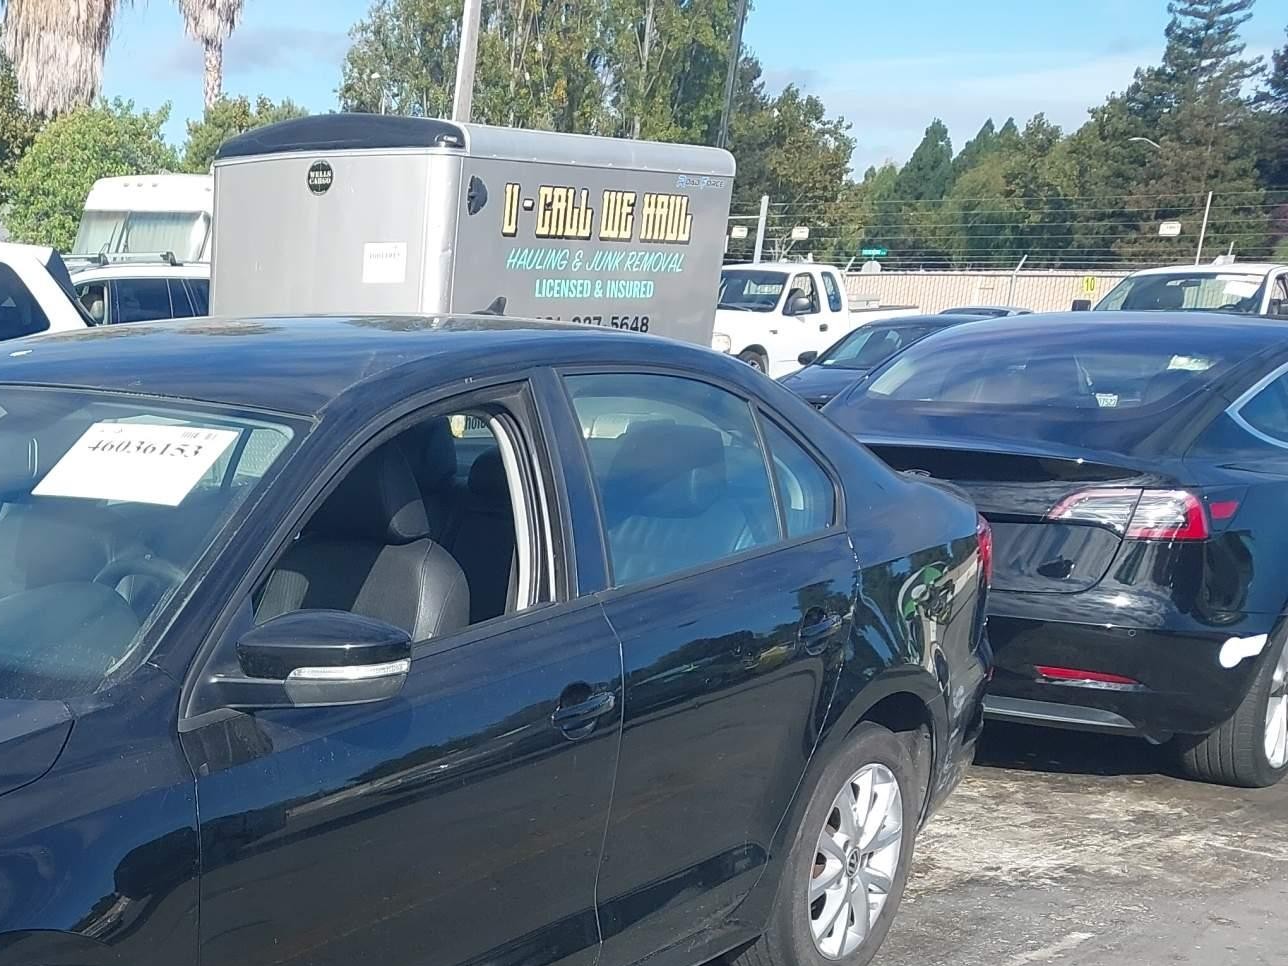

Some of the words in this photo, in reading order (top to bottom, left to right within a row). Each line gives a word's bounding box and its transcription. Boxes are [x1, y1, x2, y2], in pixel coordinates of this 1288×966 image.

[599, 189, 637, 242] WE
[640, 192, 693, 245] HAUL
[506, 248, 570, 271] HAULING
[572, 249, 584, 272] &
[586, 250, 625, 272] JUNK
[624, 251, 685, 273] REMOVAL
[535, 279, 592, 298] LICENSED
[594, 280, 603, 298] &
[606, 280, 654, 298] INSURED
[1085, 277, 1096, 292] 10
[88, 439, 204, 458] 46036153
